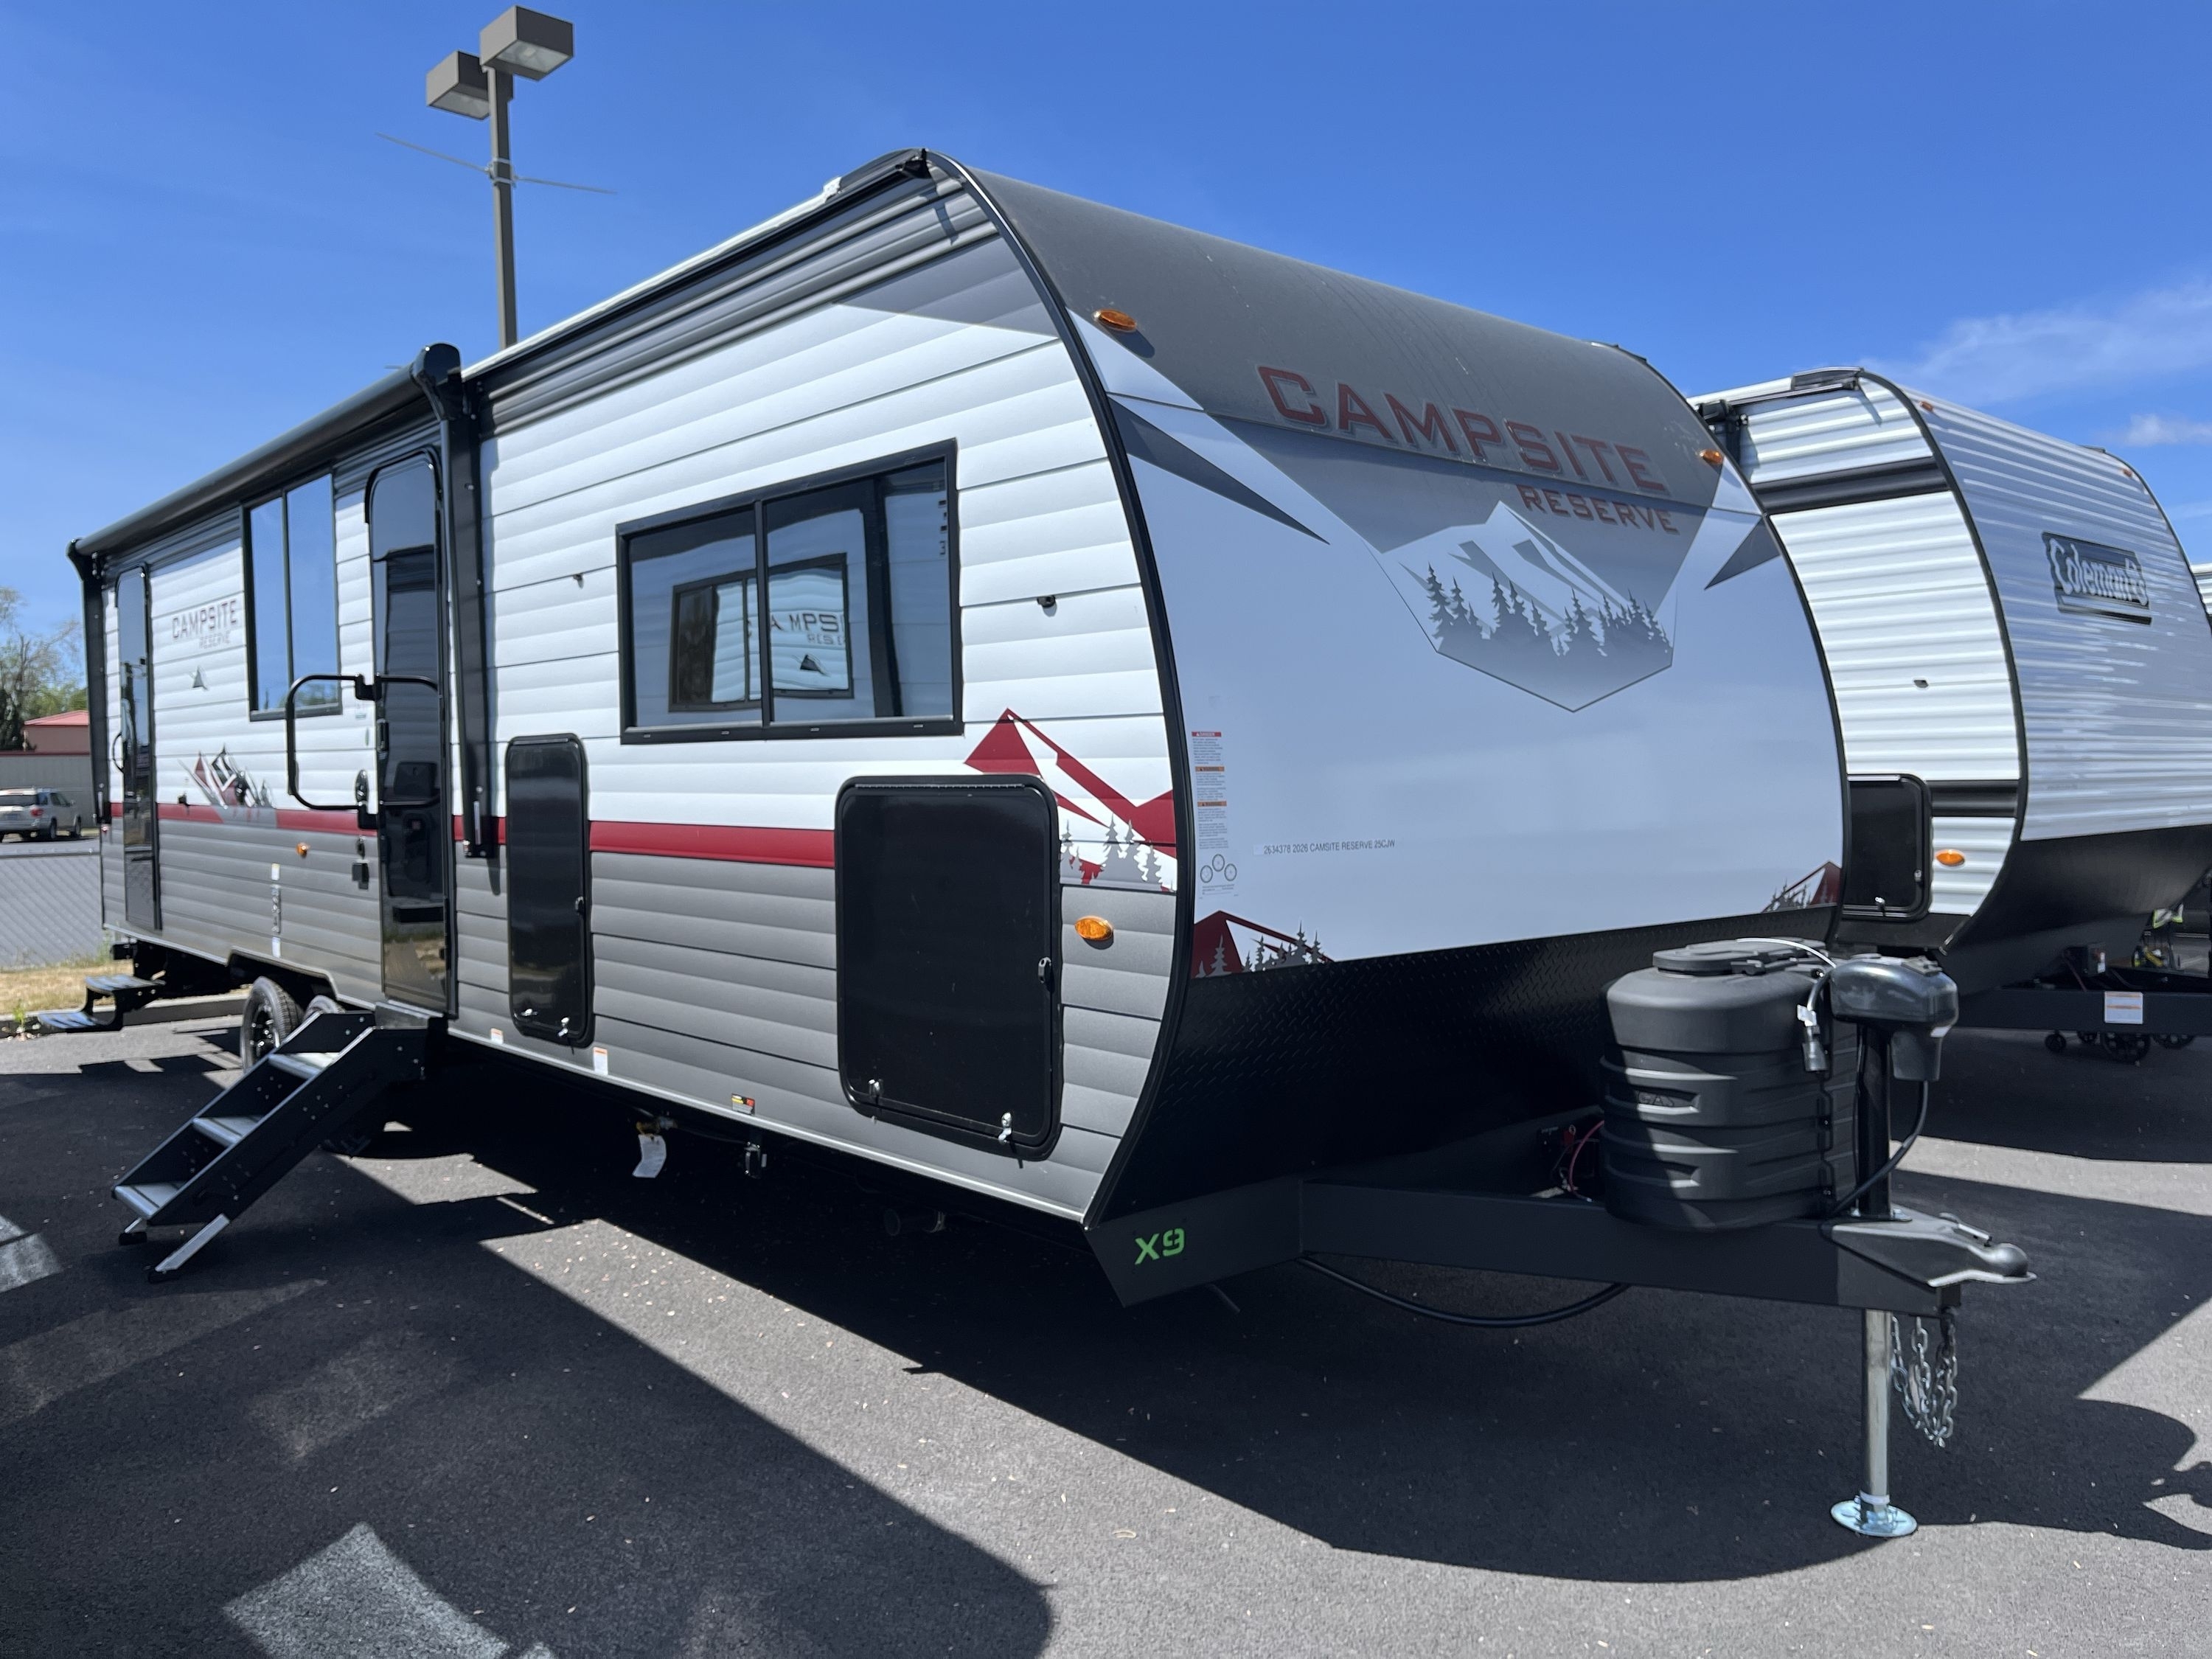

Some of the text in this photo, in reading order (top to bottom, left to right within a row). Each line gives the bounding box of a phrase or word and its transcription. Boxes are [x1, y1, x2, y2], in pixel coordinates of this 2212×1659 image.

[1257, 366, 1669, 493] CAMPSITE
[1516, 484, 1680, 535] RESERVE
[172, 599, 237, 639] CAMPSITE
[1293, 844, 1308, 854] 2026
[1310, 842, 1340, 852] CAMSITE
[1341, 840, 1373, 851] RESERVE
[1135, 1228, 1185, 1265] X9
